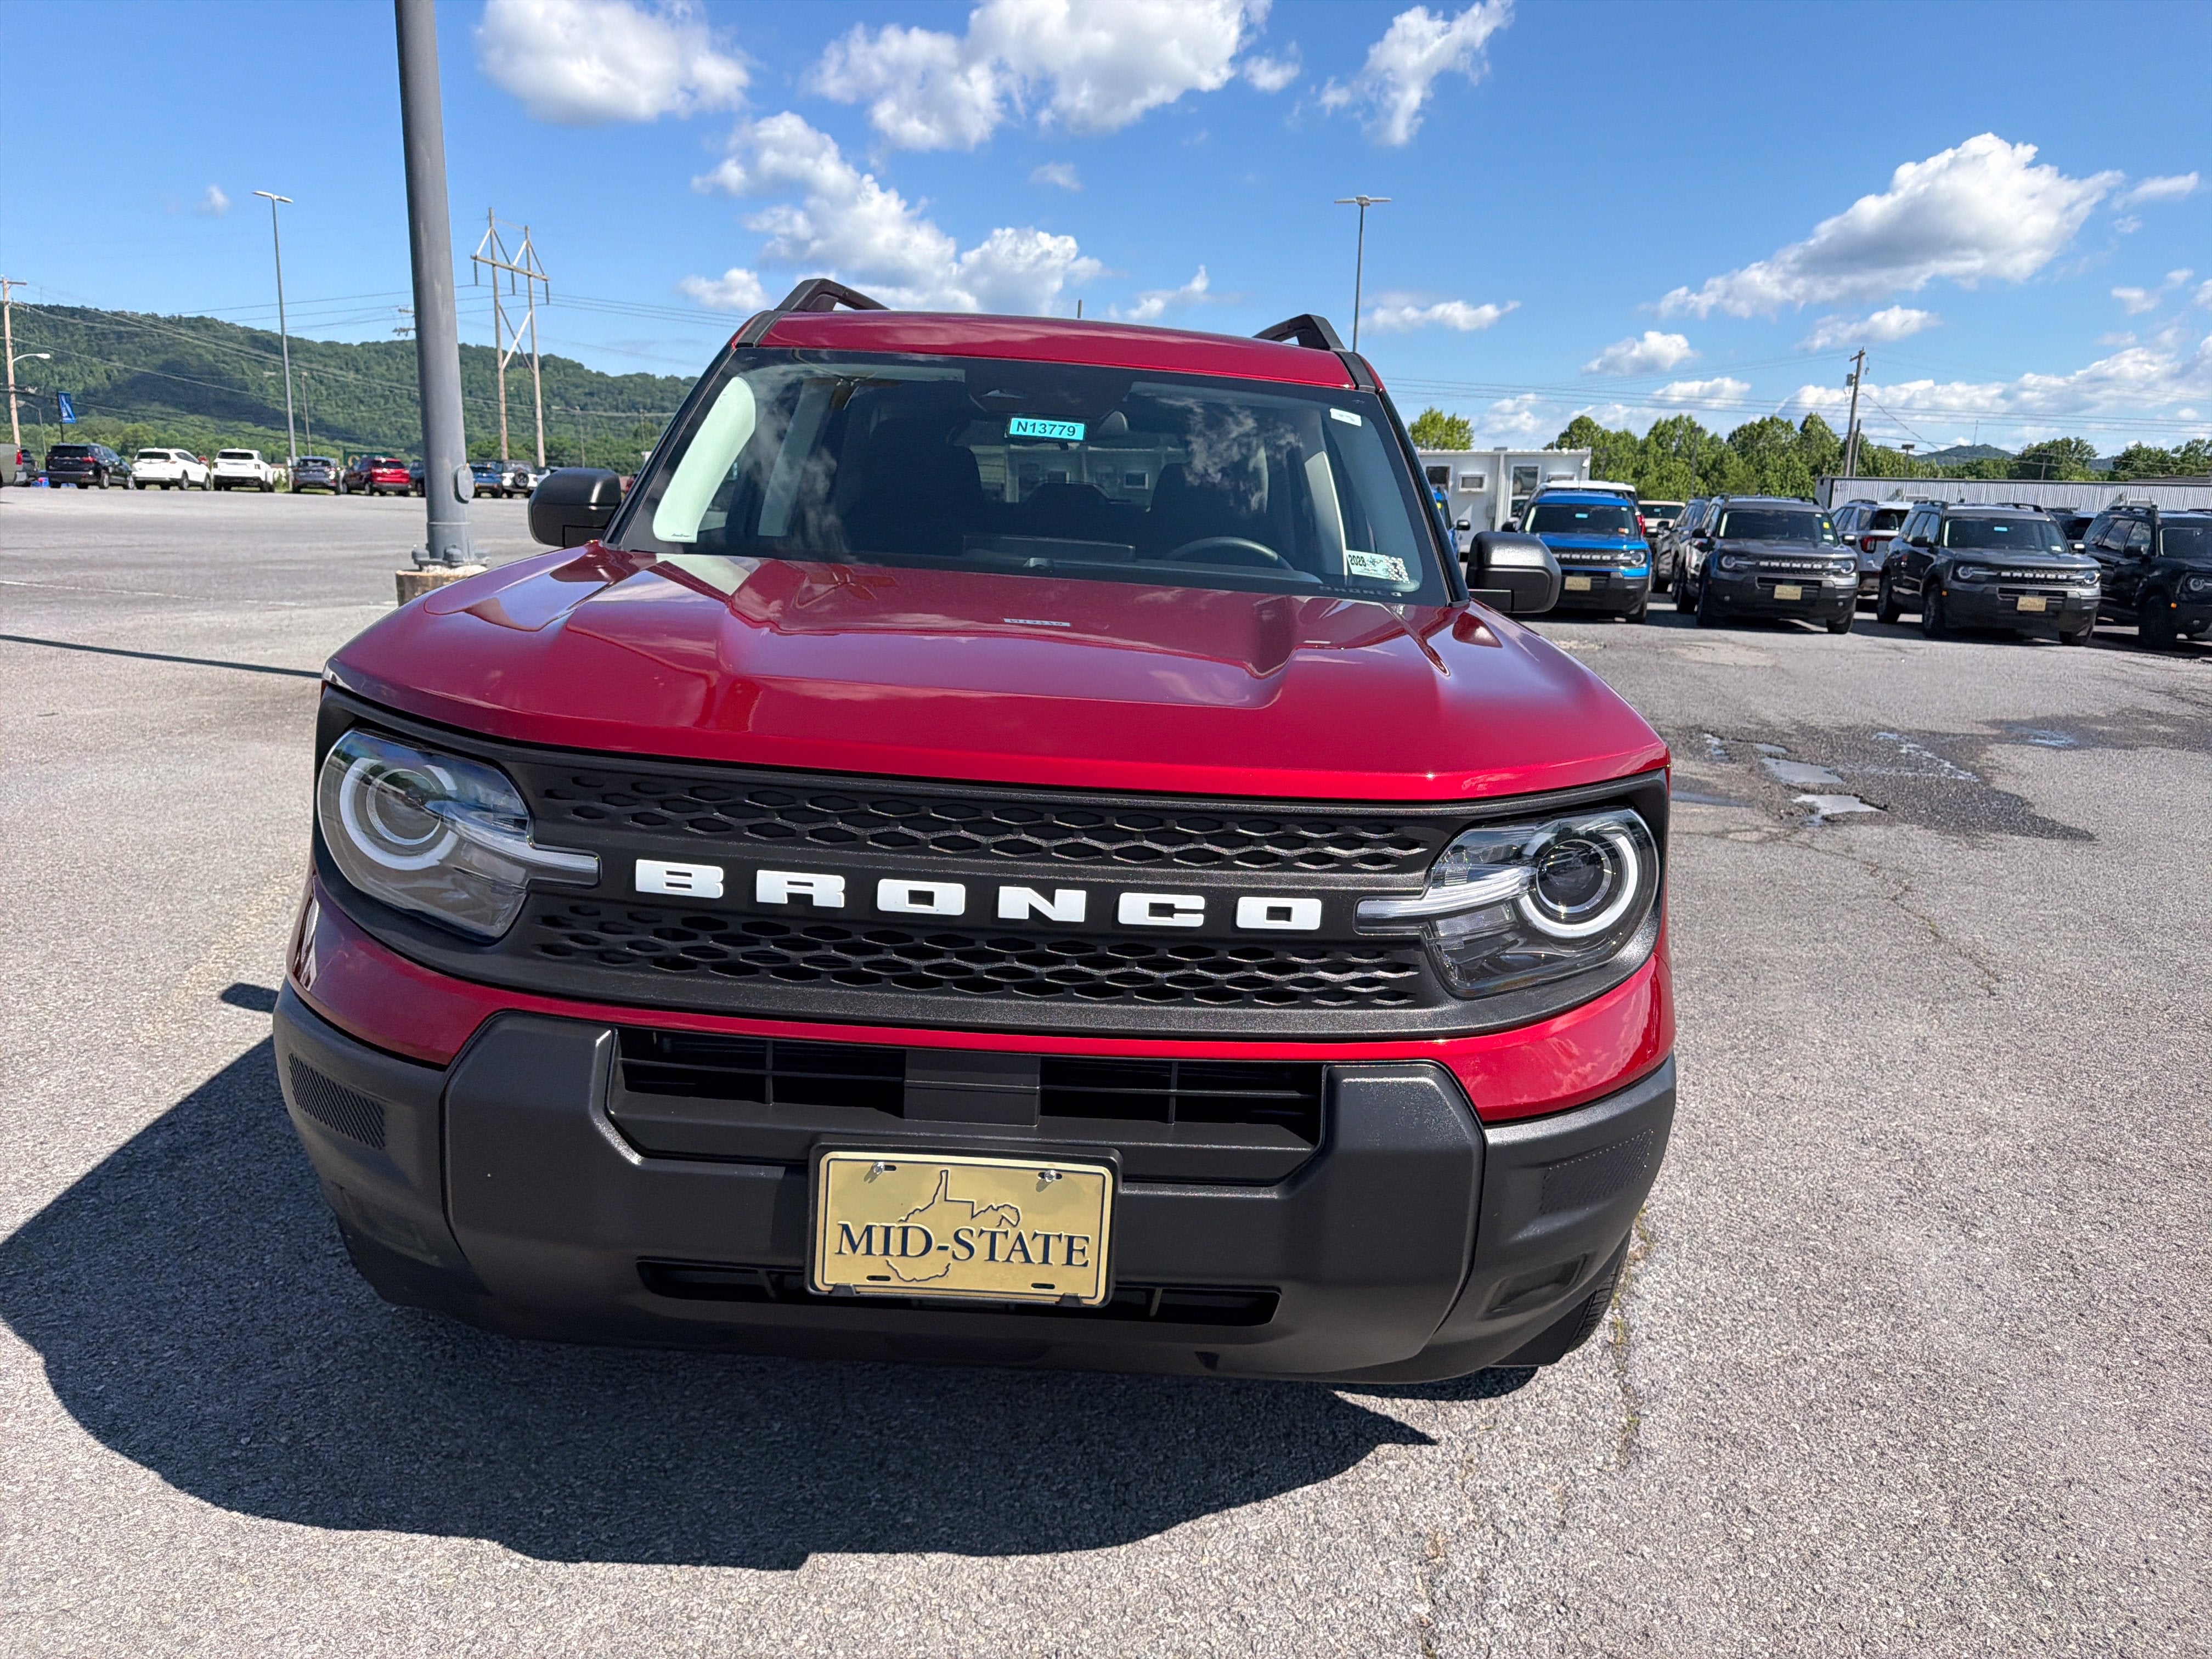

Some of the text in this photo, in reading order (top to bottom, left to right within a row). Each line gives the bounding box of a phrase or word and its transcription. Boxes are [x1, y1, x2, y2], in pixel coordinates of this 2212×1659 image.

[1017, 421, 1076, 437] N13779
[1348, 554, 1367, 567] 2028
[635, 859, 1322, 931] BRONCO
[835, 1222, 1091, 1267] MID-STATE
